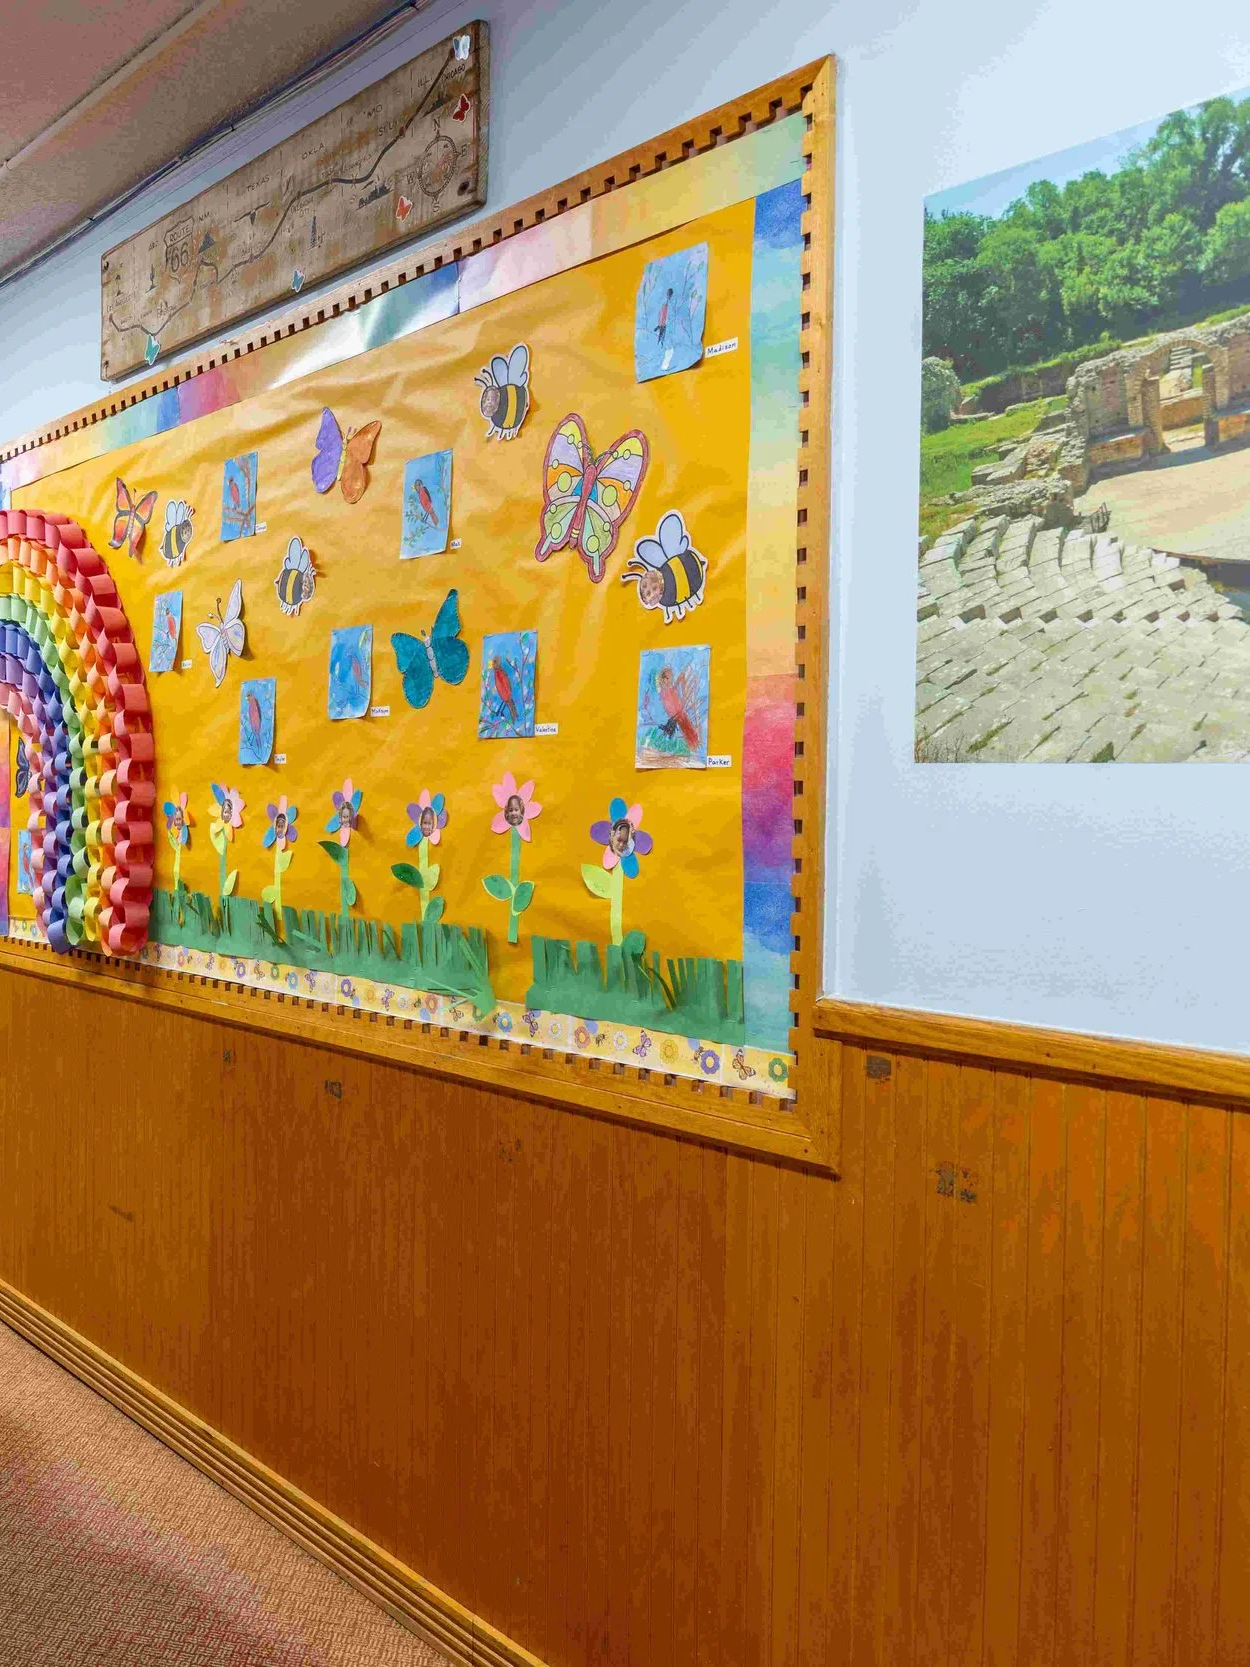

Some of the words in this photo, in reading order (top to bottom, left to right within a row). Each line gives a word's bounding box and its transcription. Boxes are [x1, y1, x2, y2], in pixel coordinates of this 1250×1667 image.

[433, 115, 442, 132] N
[301, 142, 325, 160] OKLA
[460, 143, 468, 159] E
[247, 174, 270, 193] TEXAS
[406, 173, 415, 185] W
[433, 201, 441, 213] S
[169, 223, 191, 242] ROUTE
[706, 342, 737, 355] Madison
[708, 757, 730, 766] Parker
